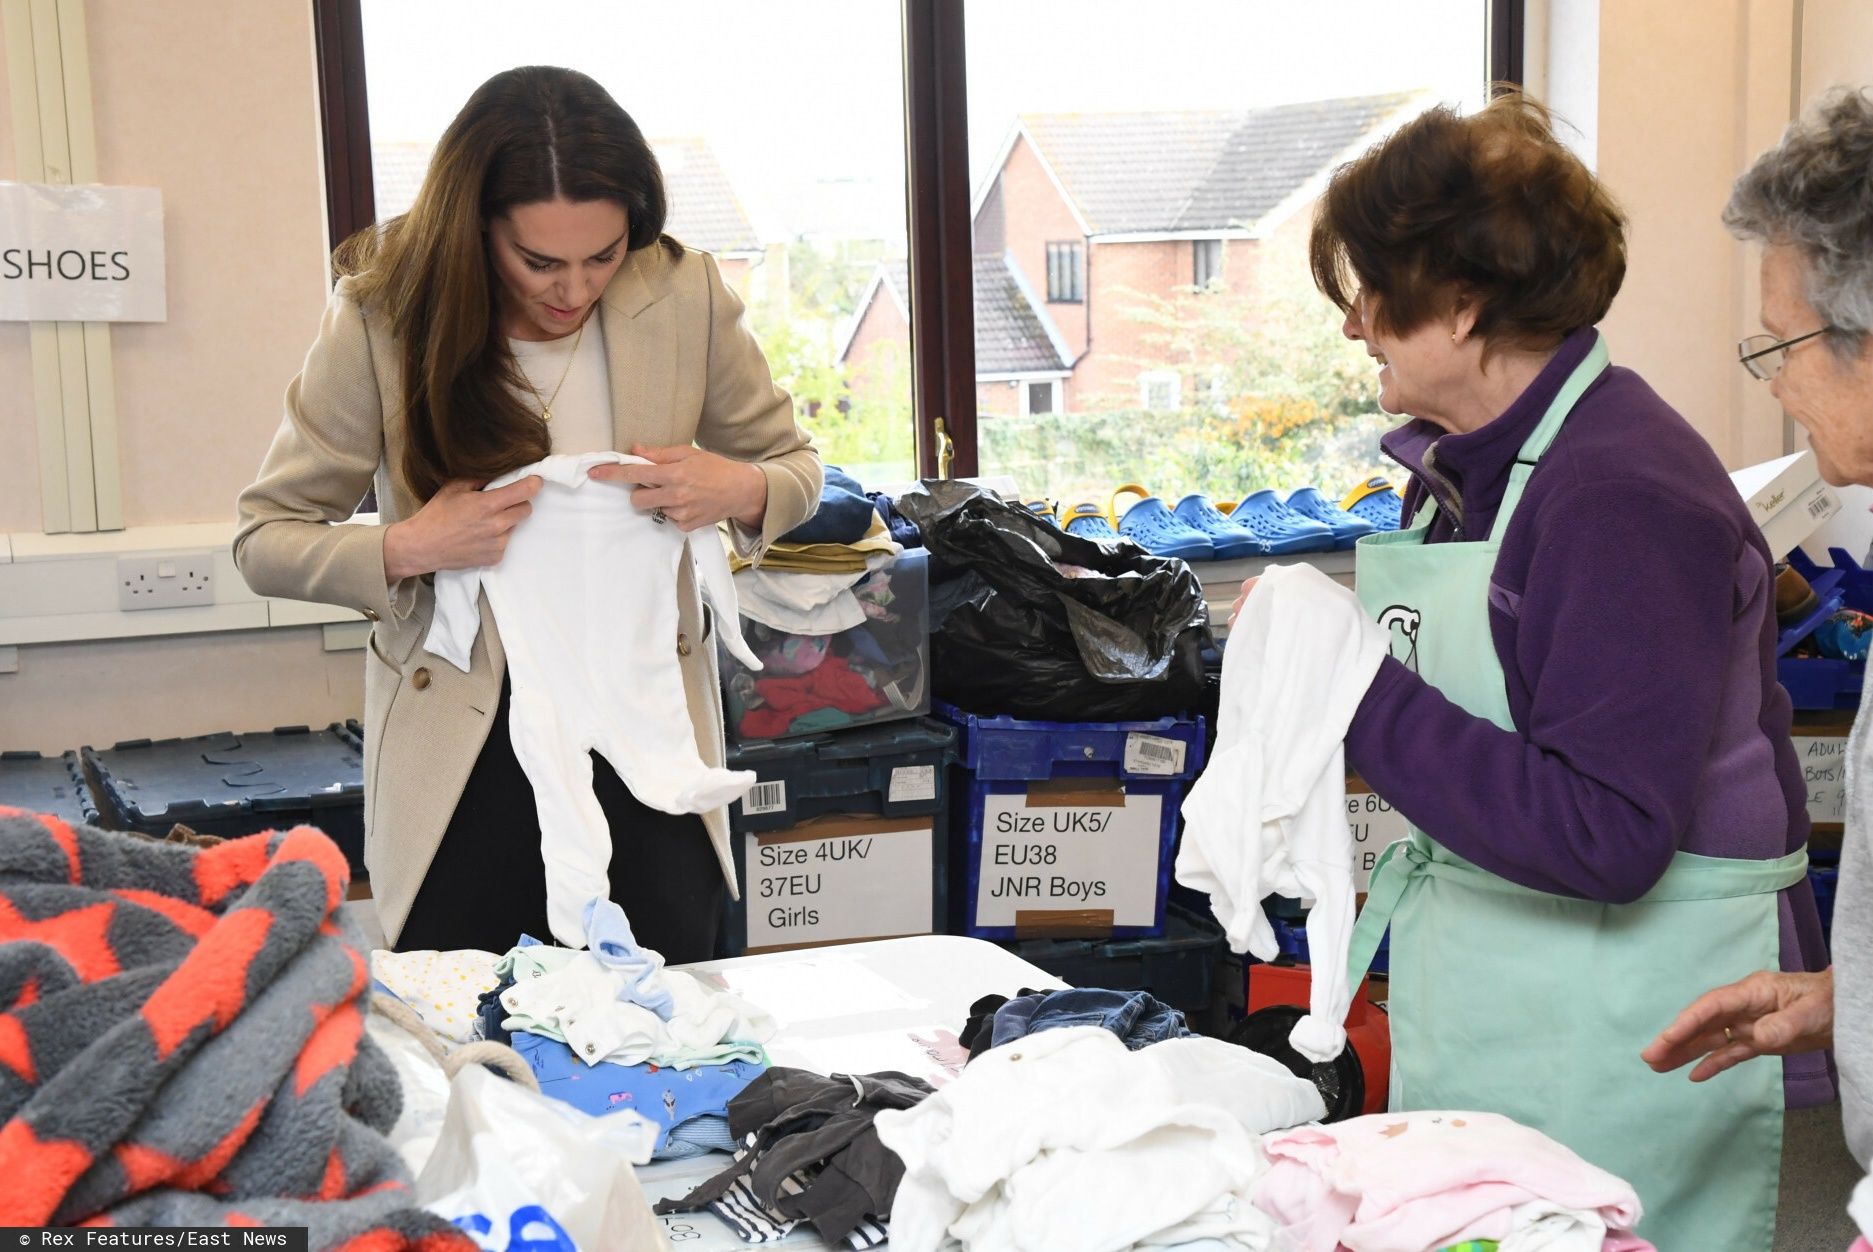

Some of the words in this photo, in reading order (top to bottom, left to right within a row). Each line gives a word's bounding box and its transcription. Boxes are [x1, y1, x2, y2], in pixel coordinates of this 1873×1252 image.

[3, 248, 130, 281] SHOES
[1346, 799, 1360, 813] e
[1366, 794, 1391, 813] 6U
[996, 812, 1045, 833] Size
[1053, 811, 1112, 833] UK5/
[1350, 823, 1369, 842] U
[760, 845, 808, 867] Size
[815, 838, 873, 861] 4UK/
[994, 844, 1057, 865] EU38
[1363, 852, 1376, 870] B
[760, 874, 821, 897] 37EU
[991, 877, 1041, 897] JNR
[1050, 877, 1106, 901] Boys
[768, 906, 819, 928] Girls
